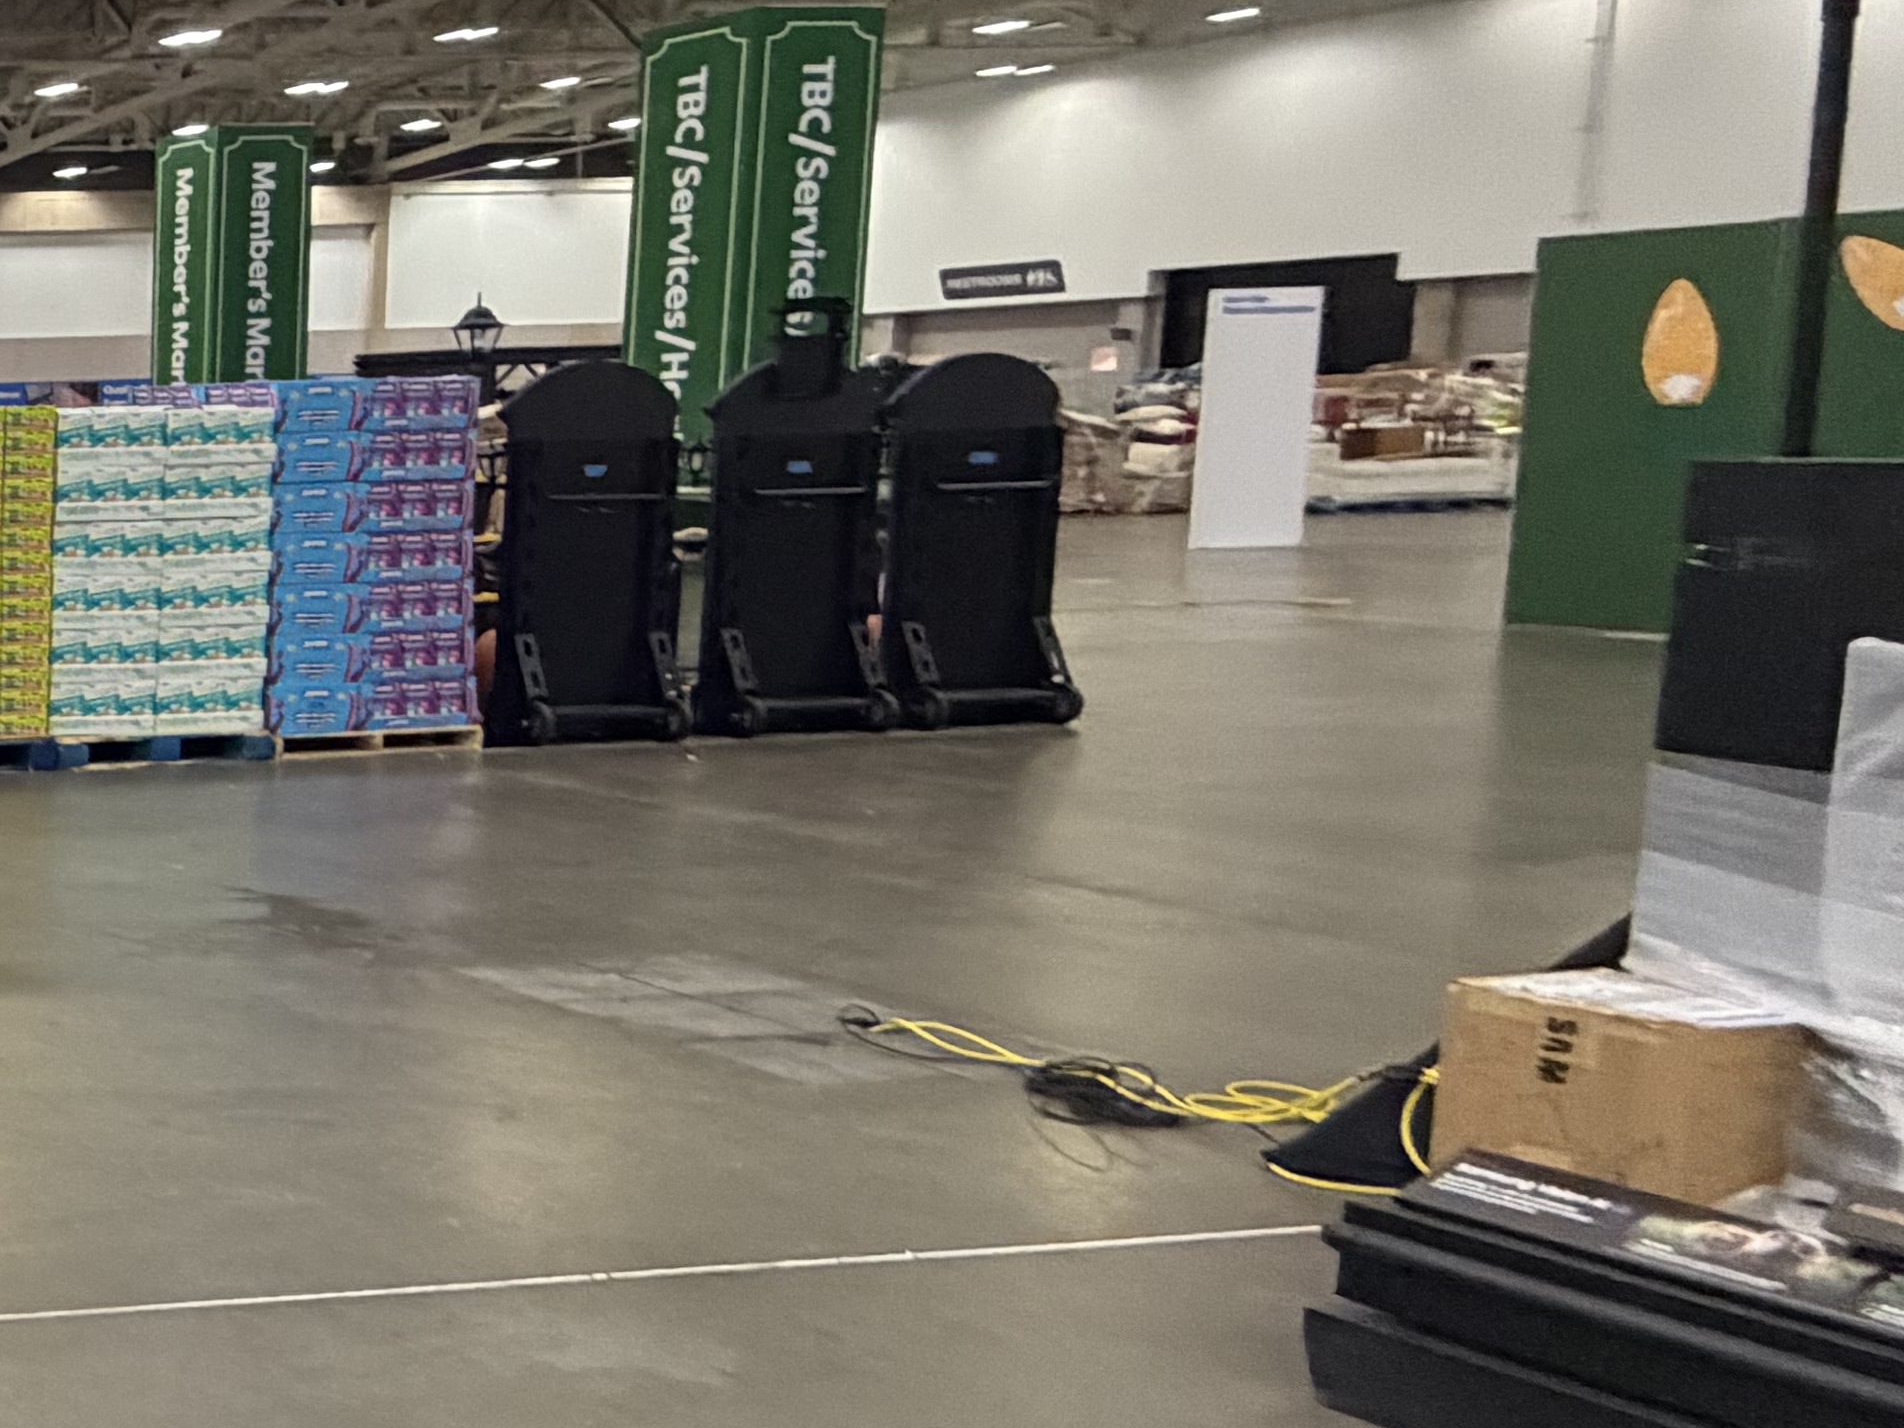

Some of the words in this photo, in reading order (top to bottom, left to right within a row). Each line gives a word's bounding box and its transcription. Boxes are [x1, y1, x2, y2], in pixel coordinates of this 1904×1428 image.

[172, 167, 194, 317] Member's
[247, 161, 277, 313] Member's
[170, 321, 189, 386] Mar
[244, 318, 272, 382] Mar
